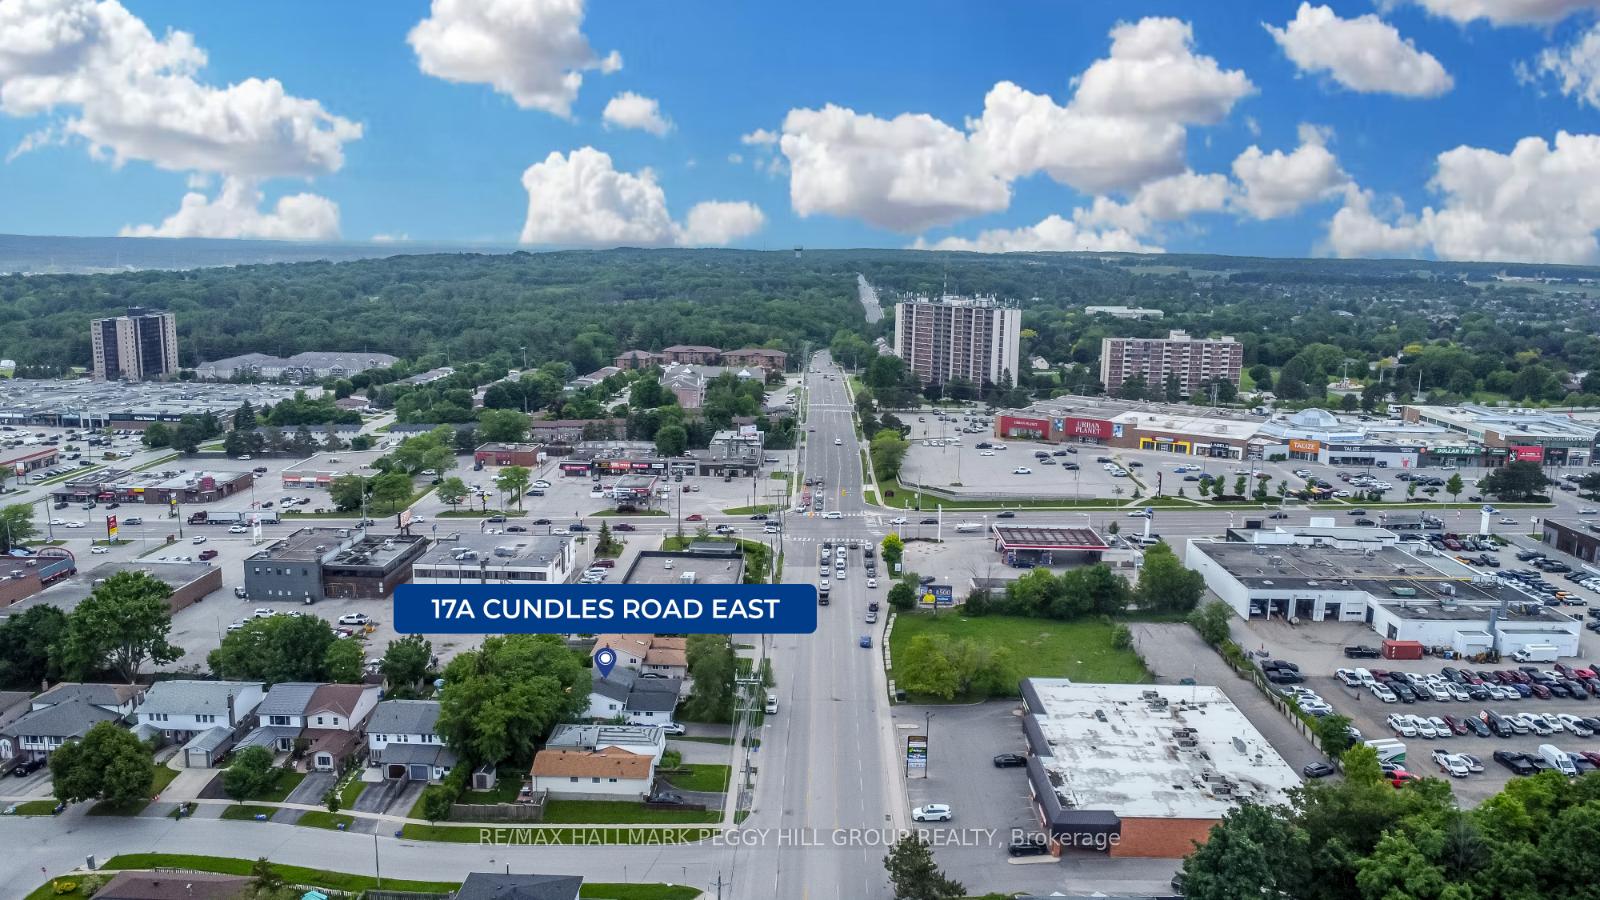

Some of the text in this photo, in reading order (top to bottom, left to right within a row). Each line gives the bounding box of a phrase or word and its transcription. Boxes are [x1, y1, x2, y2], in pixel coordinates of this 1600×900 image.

[1077, 421, 1099, 429] URBAN
[1075, 427, 1101, 435] PLANET
[1294, 442, 1316, 450] TALIZE
